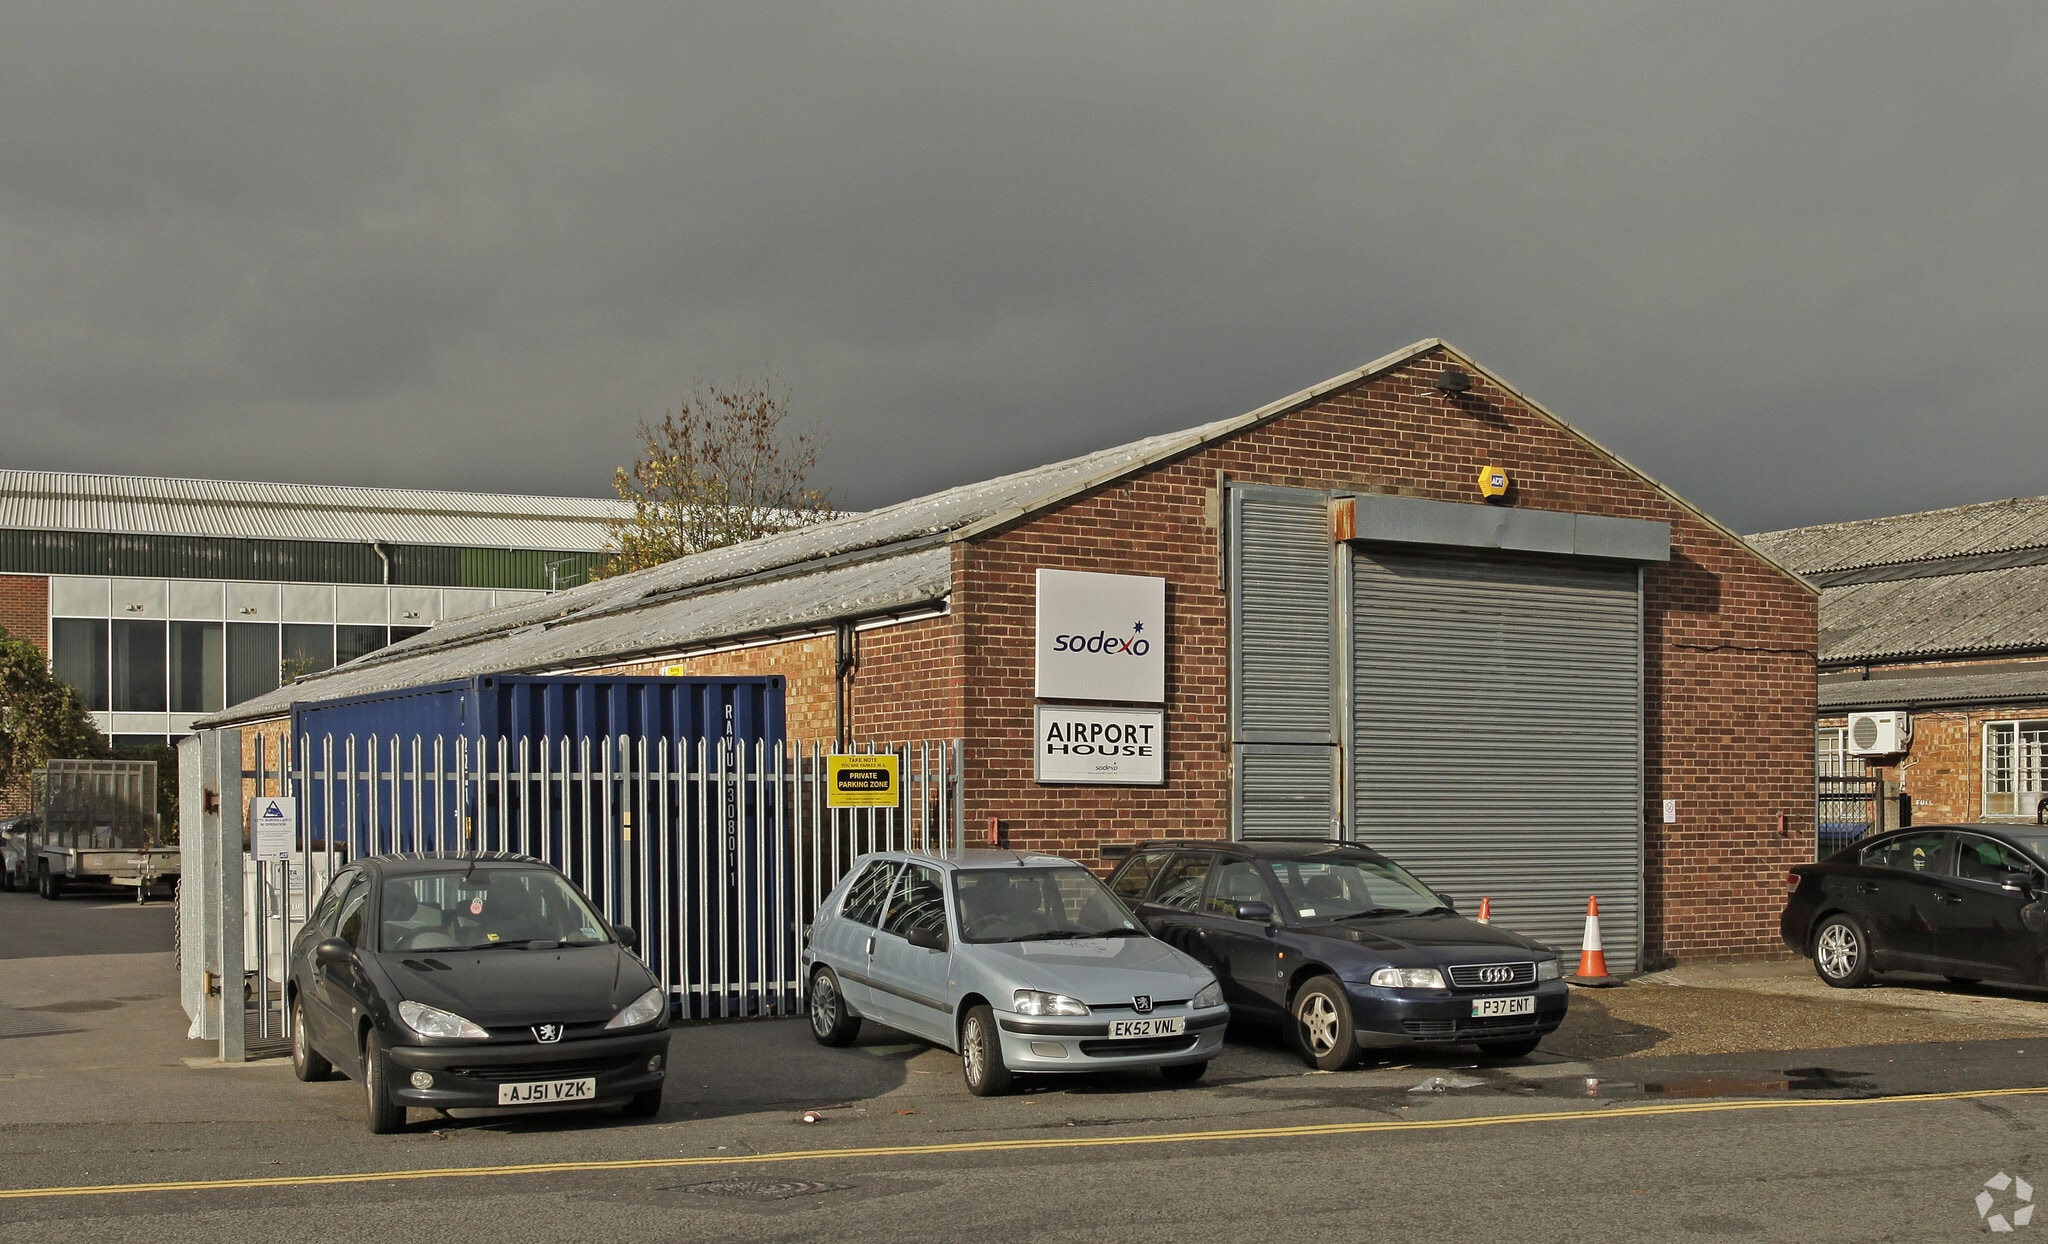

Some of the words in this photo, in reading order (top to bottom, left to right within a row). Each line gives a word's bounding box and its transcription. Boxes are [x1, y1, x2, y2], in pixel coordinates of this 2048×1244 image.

[1053, 629, 1150, 656] sodexo
[725, 704, 734, 767] RAVU
[1046, 722, 1154, 744] AIRPORT
[1047, 744, 1153, 757] HOUSE
[1483, 1000, 1507, 1014] P37
[1509, 998, 1530, 1012] ENT
[1115, 1021, 1150, 1036] EK52
[1154, 1019, 1177, 1034] VNL
[510, 1084, 548, 1101] AJ51
[554, 1081, 586, 1098] VZK
